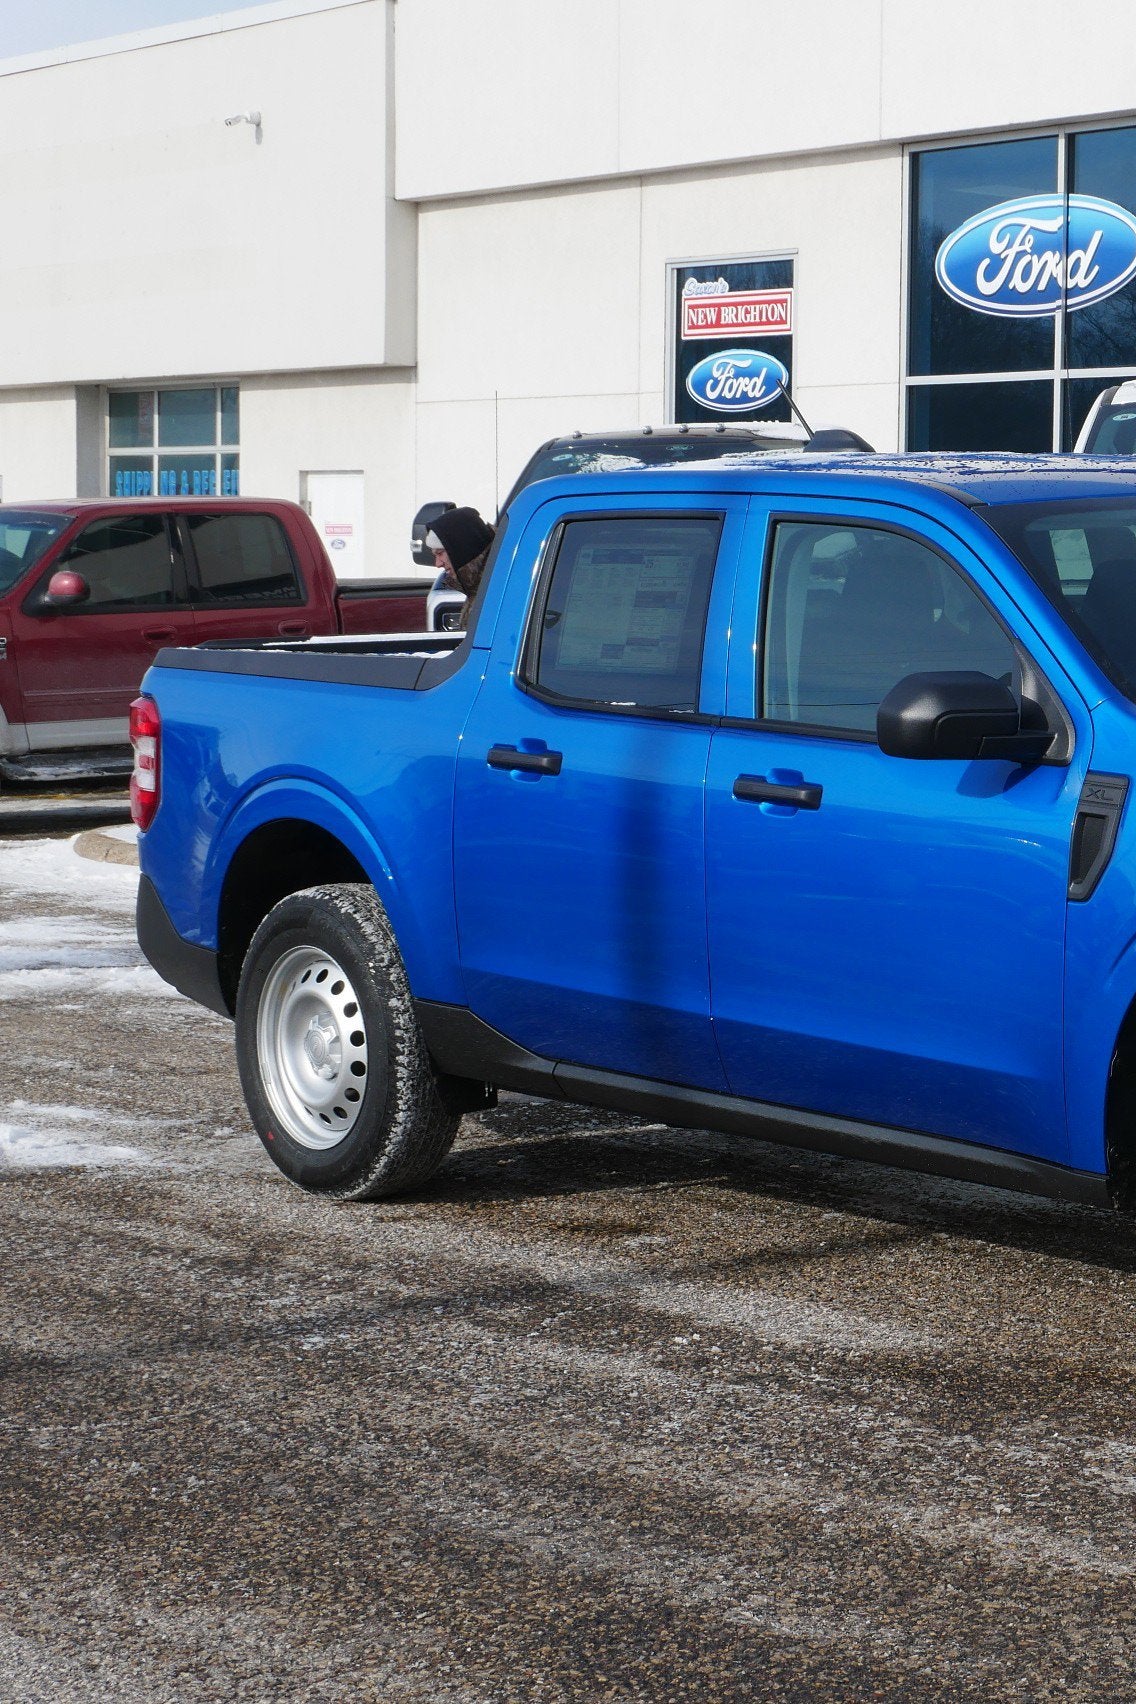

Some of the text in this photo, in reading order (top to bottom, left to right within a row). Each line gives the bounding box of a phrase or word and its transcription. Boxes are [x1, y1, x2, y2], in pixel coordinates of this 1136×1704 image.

[977, 215, 1103, 295] Ford
[688, 303, 787, 326] NEW BRIGHTON
[706, 358, 767, 400] Ford
[116, 470, 176, 496] SHIPPNG
[1085, 787, 1113, 801] XL
